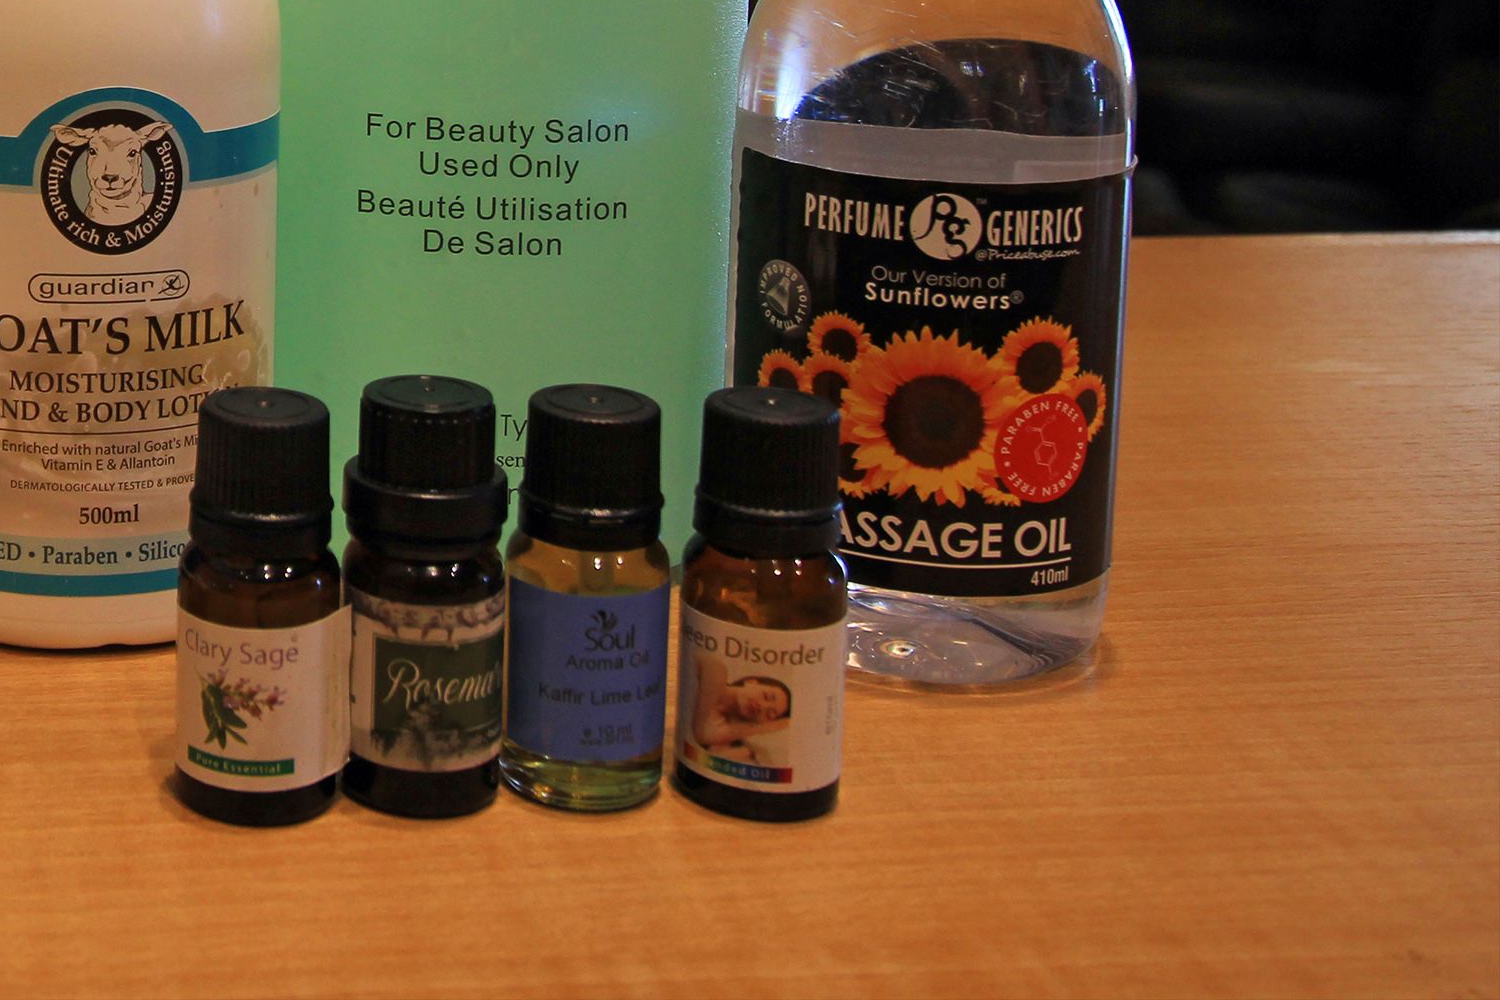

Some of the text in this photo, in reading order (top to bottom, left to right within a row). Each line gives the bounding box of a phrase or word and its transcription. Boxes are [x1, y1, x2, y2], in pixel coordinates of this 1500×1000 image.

[366, 113, 629, 149] For Beauty Salon
[418, 151, 579, 183] Used Only
[48, 140, 175, 247] Ultimate rich & Moisturising
[356, 189, 627, 221] Beauté Utilisation
[804, 192, 905, 241] PERFUME
[986, 206, 1083, 247] GENERICS
[423, 229, 562, 257] De Salon
[39, 278, 154, 298] guardian
[871, 265, 1007, 289] Our Version of
[145, 300, 245, 352] MILK
[9, 363, 204, 394] MOISTURISING
[48, 402, 69, 423] &
[76, 401, 151, 423] BODY
[157, 388, 220, 419] LOT
[1000, 401, 1079, 455] PARABEN FREE
[2, 439, 58, 455] Enriched
[61, 443, 92, 456] with
[95, 442, 141, 456] natural
[144, 437, 181, 453] Goat's
[41, 455, 175, 471] Vitamin E & Allantoin
[1008, 442, 1084, 496] PARABEN FREE
[10, 473, 195, 492] DERMATOLOGICALLY TESTED & PROVE
[79, 504, 140, 525] 500ml
[839, 510, 1072, 559] ASSAGE OIL
[42, 545, 118, 565] Paraben
[138, 539, 186, 562] Silico
[1030, 566, 1069, 586] 410ml
[185, 628, 299, 670] Clary Sage
[584, 624, 635, 652] Soul
[725, 636, 825, 665] Disorder
[565, 650, 649, 671] Aroma Oil
[591, 690, 632, 706] Lime
[223, 761, 281, 774] Essential
